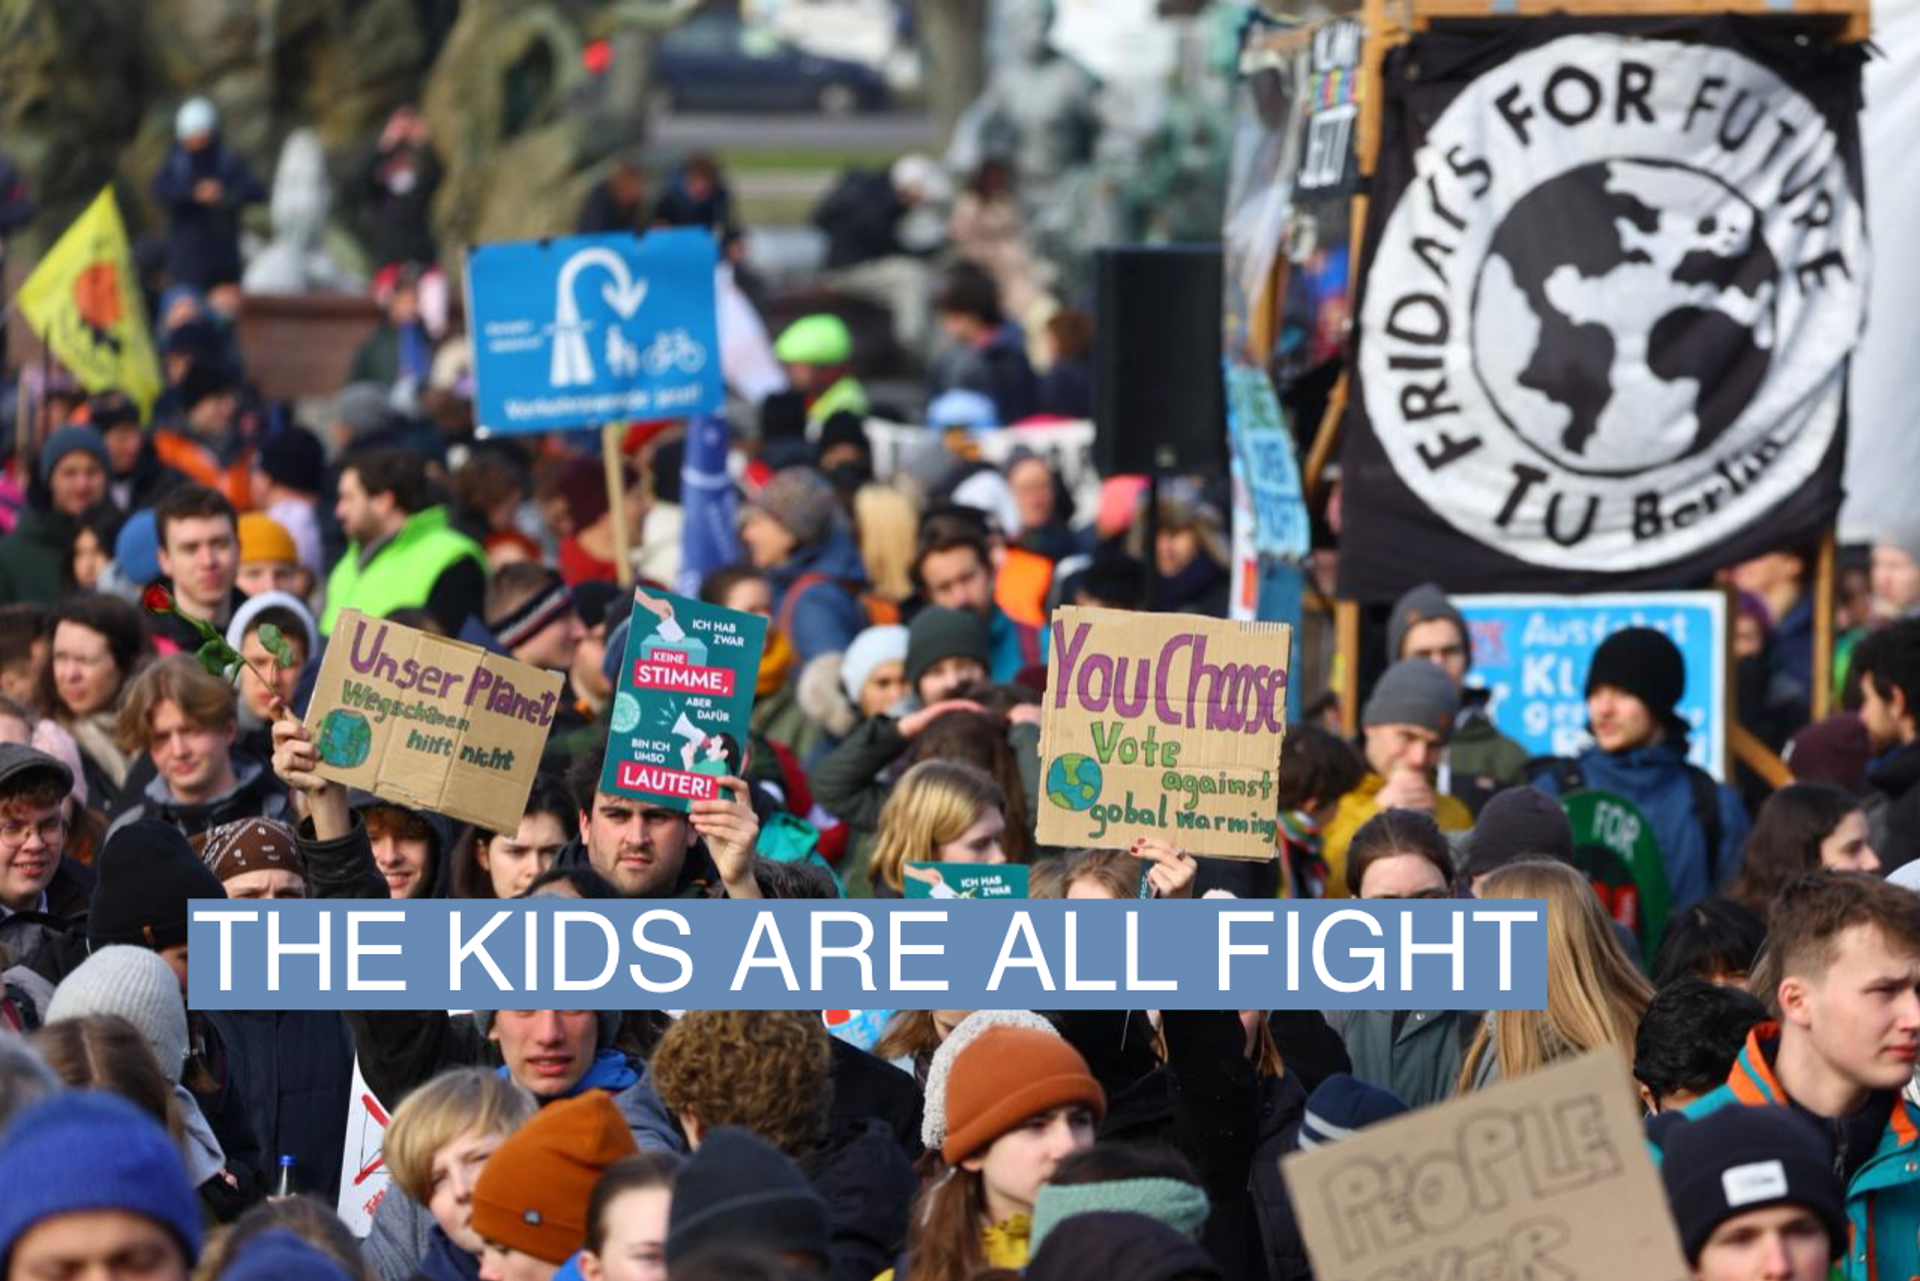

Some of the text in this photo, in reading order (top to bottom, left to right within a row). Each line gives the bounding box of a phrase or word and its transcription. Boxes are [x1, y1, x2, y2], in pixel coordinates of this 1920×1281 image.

[1384, 61, 1853, 472] FRIDAYS FOR FUTURE
[1494, 436, 1784, 547] TU Berlin
[692, 618, 737, 634] ICH HAB
[713, 633, 745, 648] ZWAR
[653, 651, 685, 664] KEINE
[350, 619, 464, 699] Unser
[463, 664, 557, 728] Planet
[638, 664, 729, 694] STIMME,
[685, 696, 712, 709] ABER
[697, 708, 730, 723] DAFÜR
[459, 743, 516, 772] nicht
[631, 737, 671, 752] BIN ICH
[634, 750, 666, 764] UMSO
[1090, 719, 1182, 768] Vote
[623, 765, 712, 799] LAUTER!
[1161, 769, 1273, 811] against
[1088, 788, 1278, 844] gobal warming
[1591, 800, 1642, 862] FOR
[960, 875, 1002, 889] ICH HAB
[982, 885, 1012, 897] ZWAR
[1319, 1093, 1626, 1262] PEOPLE
